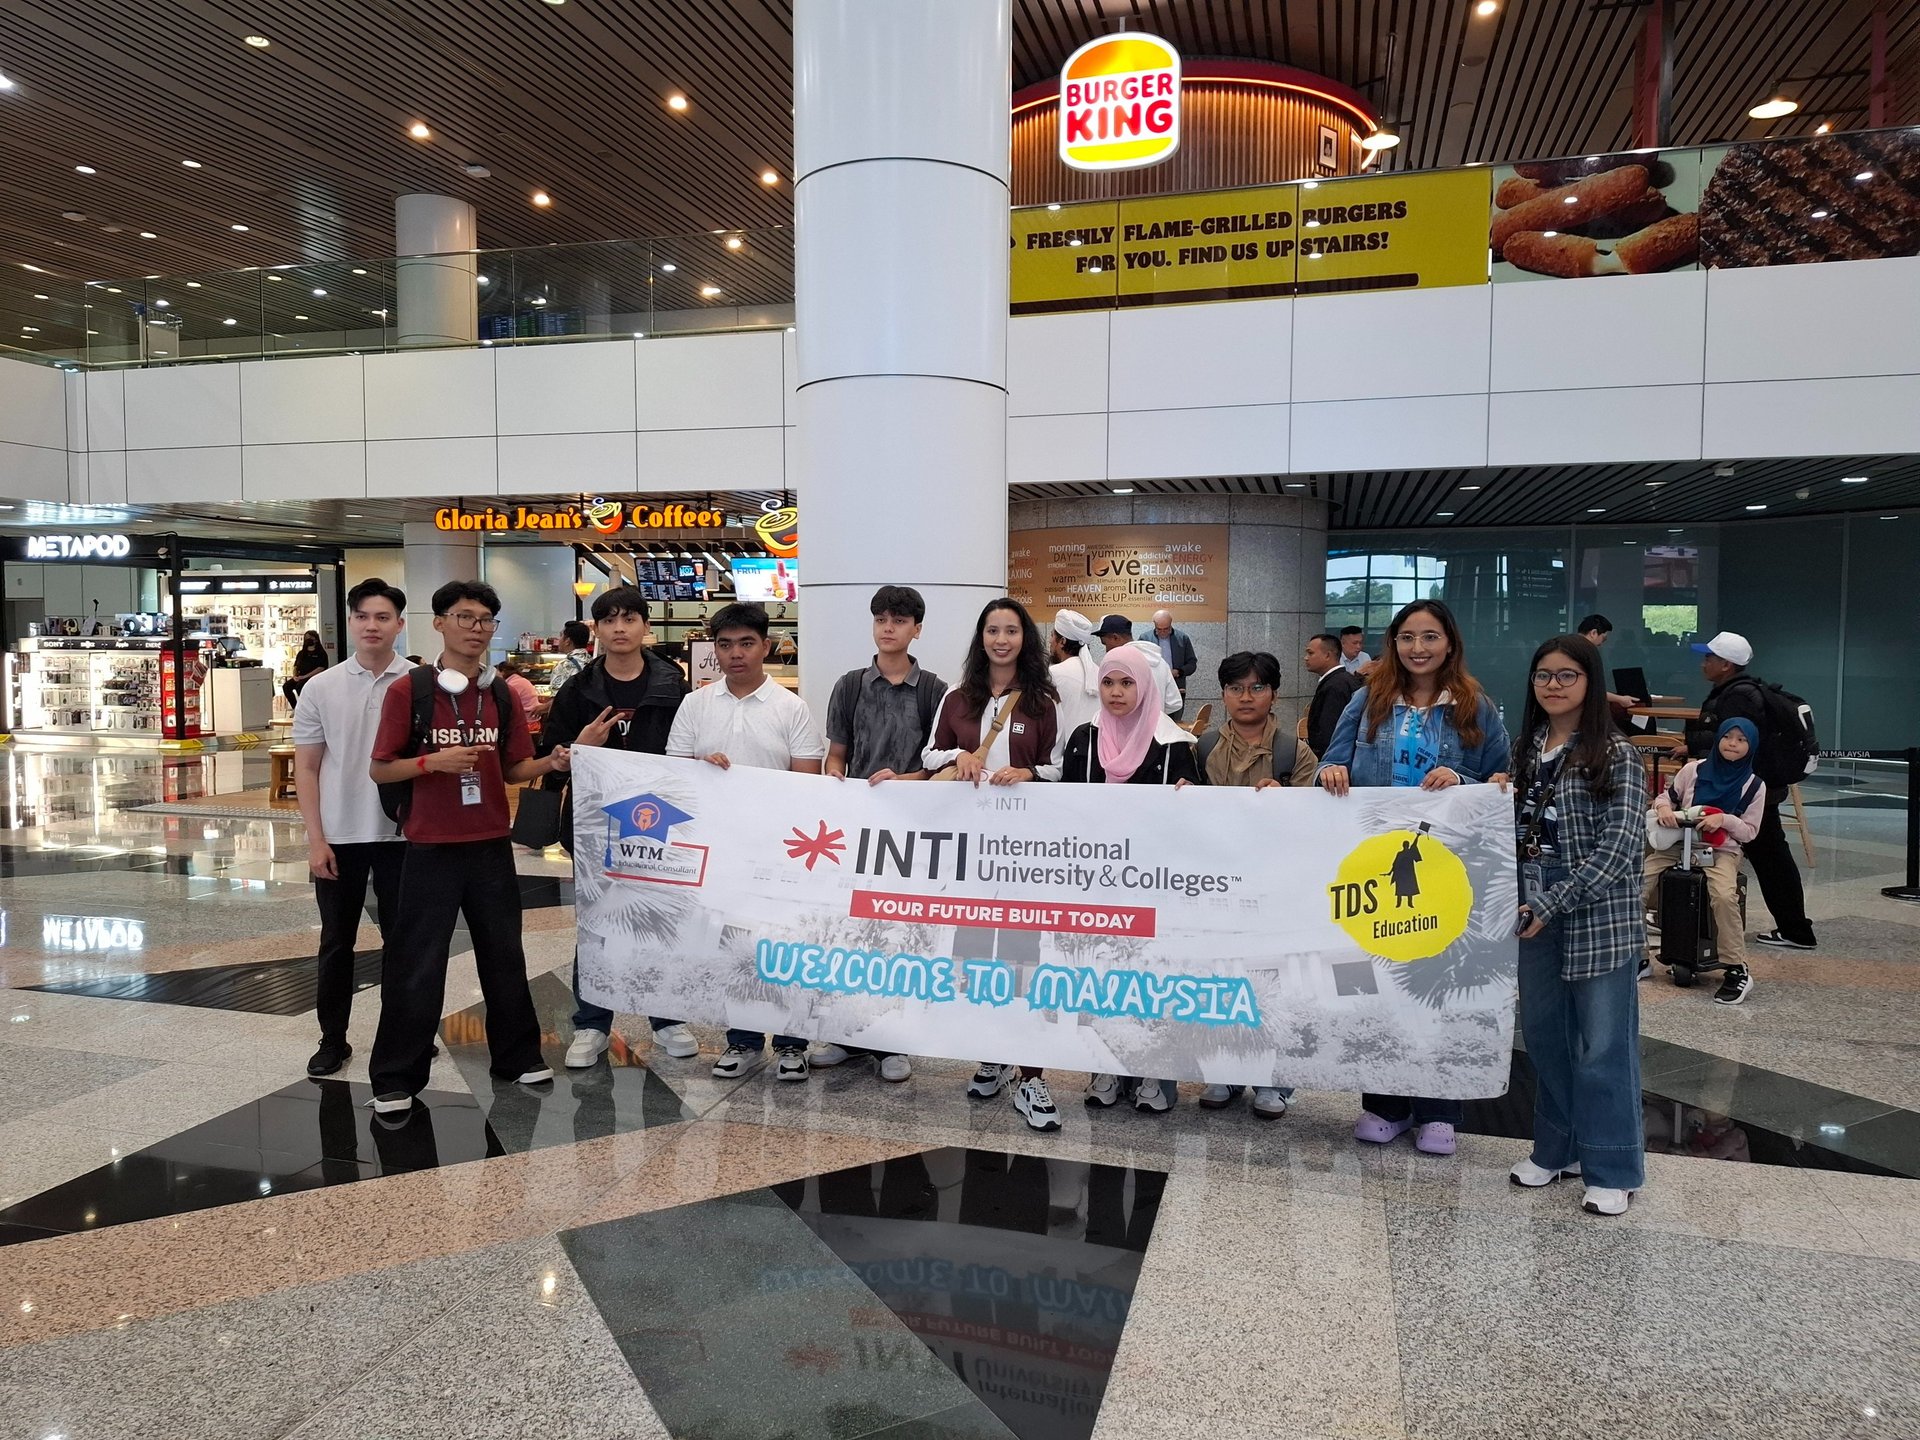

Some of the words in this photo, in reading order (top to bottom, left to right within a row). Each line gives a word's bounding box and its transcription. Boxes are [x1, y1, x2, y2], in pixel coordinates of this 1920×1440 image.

[1067, 73, 1172, 107] BURGER
[1067, 100, 1173, 143] KING
[1027, 226, 1115, 249] FRESHLY
[1124, 212, 1292, 242] FLAME-GRILLED
[1302, 201, 1407, 226] BURGERS
[1076, 255, 1115, 273] FOR
[1124, 250, 1172, 269] YOU.
[1179, 246, 1227, 265] FIND
[1231, 243, 1258, 261] US
[435, 508, 508, 530] Gloria
[514, 507, 583, 529] Jean's
[632, 505, 722, 528] Coffees
[28, 535, 130, 558] METAPOD
[1048, 543, 1086, 553] morning
[1165, 541, 1202, 552] awake
[1052, 575, 1076, 583] warm
[1141, 564, 1204, 576] RELAXING
[1067, 584, 1102, 593] HEAVEN
[1128, 578, 1155, 594] life
[1155, 591, 1205, 602] delicious
[995, 797, 1027, 811] INTI
[620, 844, 664, 860] WTM
[855, 828, 968, 881] INTI
[978, 833, 1130, 861] International
[657, 865, 697, 875] Consultant
[978, 859, 1095, 891] University
[1330, 879, 1378, 920] TDS
[872, 898, 923, 917] YOUR
[928, 903, 1003, 922] FUTURE
[1008, 908, 1063, 925] BUILT
[1068, 911, 1136, 929] TODAY
[1373, 913, 1438, 939] Education
[966, 964, 1010, 1002] TO
